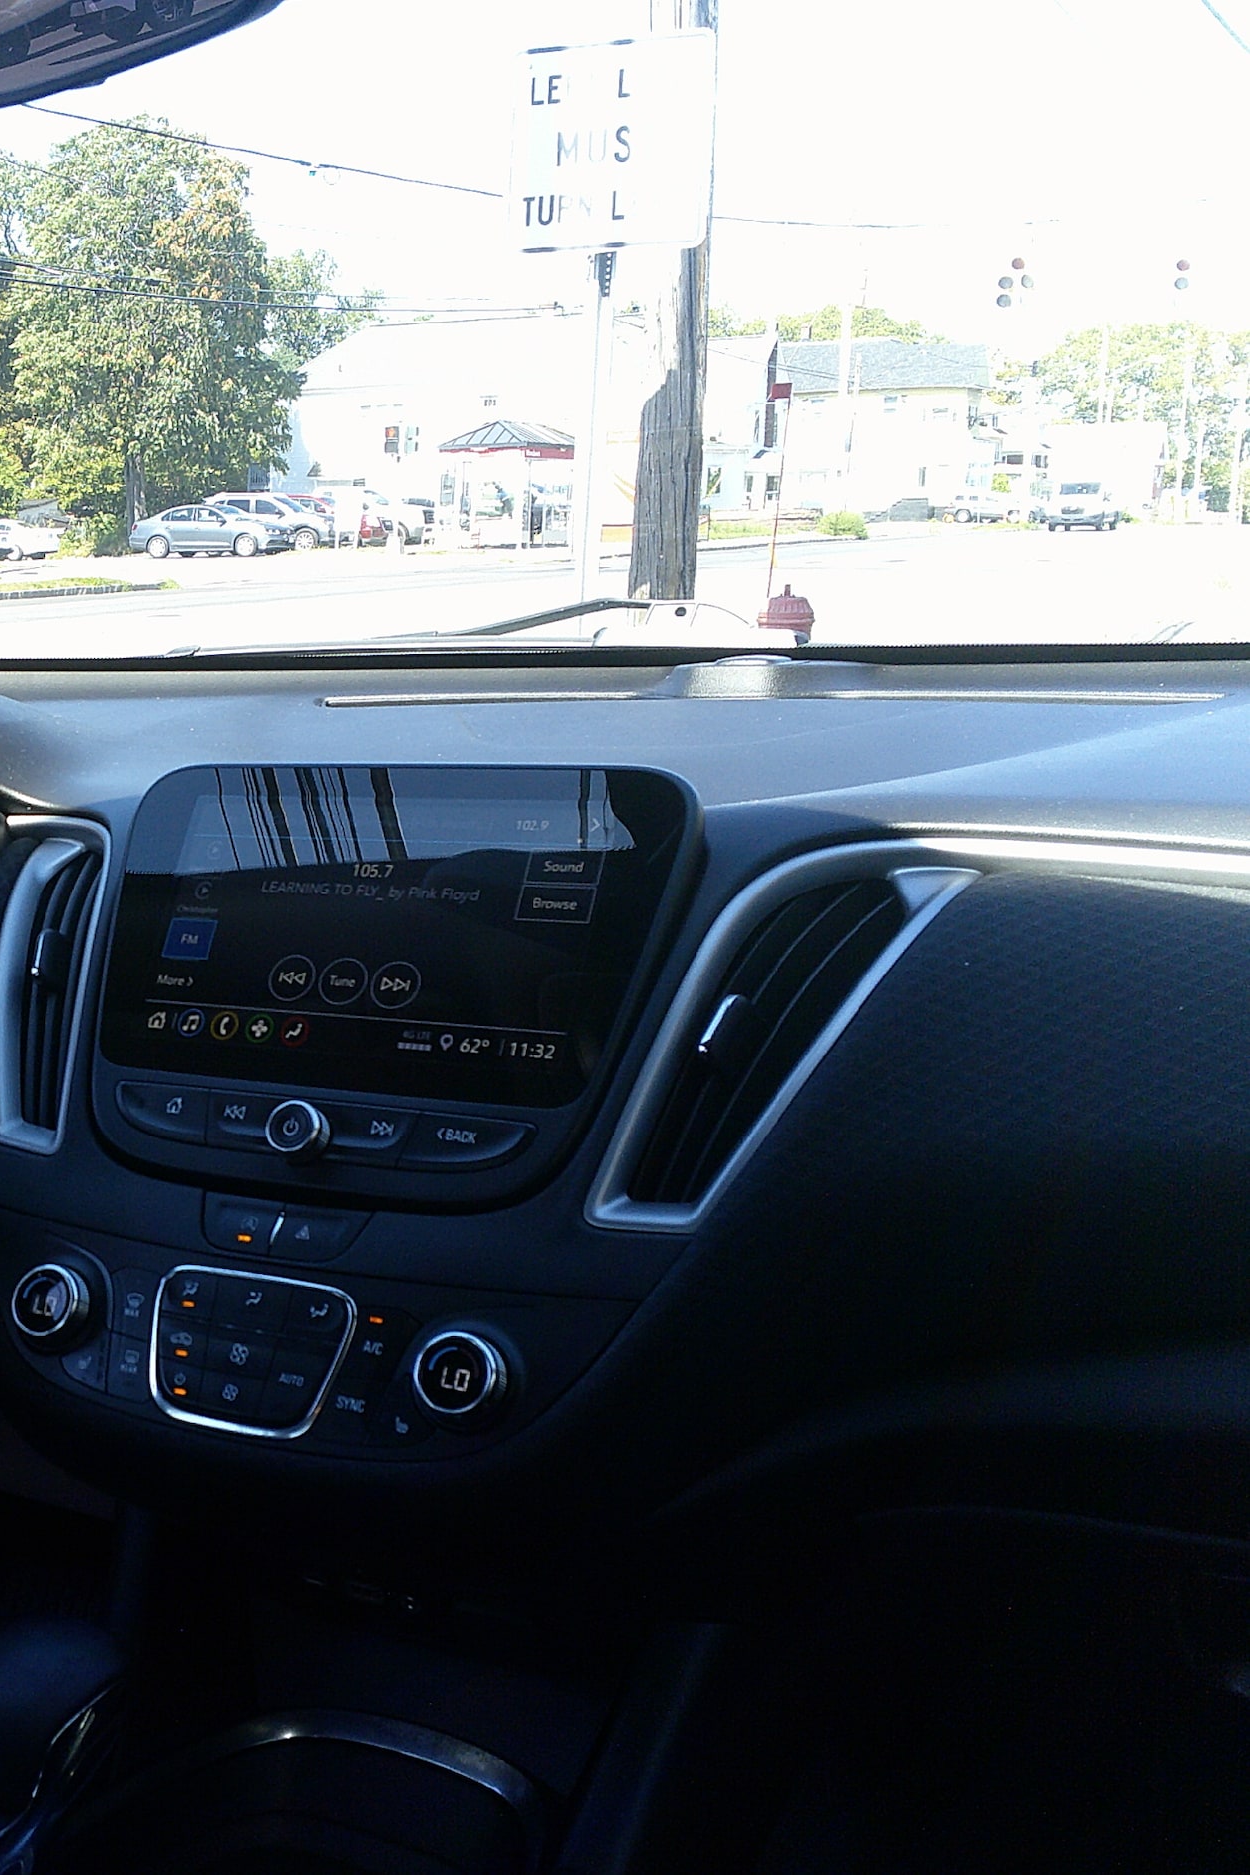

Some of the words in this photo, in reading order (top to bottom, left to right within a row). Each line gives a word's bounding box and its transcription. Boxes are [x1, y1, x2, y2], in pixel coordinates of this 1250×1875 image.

[516, 820, 551, 832] 102.9
[352, 863, 395, 879] 105.7
[543, 860, 585, 874] Sound
[260, 880, 331, 896] LEARNING
[335, 883, 352, 896] TO
[388, 884, 405, 900] by
[408, 886, 437, 899] Pink
[441, 887, 481, 904] Floyd
[532, 896, 579, 911] Browse
[180, 933, 200, 945] FM
[156, 973, 186, 986] More
[328, 974, 356, 988] Tune
[510, 1041, 556, 1060] 11:32
[445, 1128, 478, 1145] BACK
[362, 1339, 384, 1356] A/C
[278, 1372, 305, 1388] AUTO
[334, 1394, 366, 1414] SYNC
